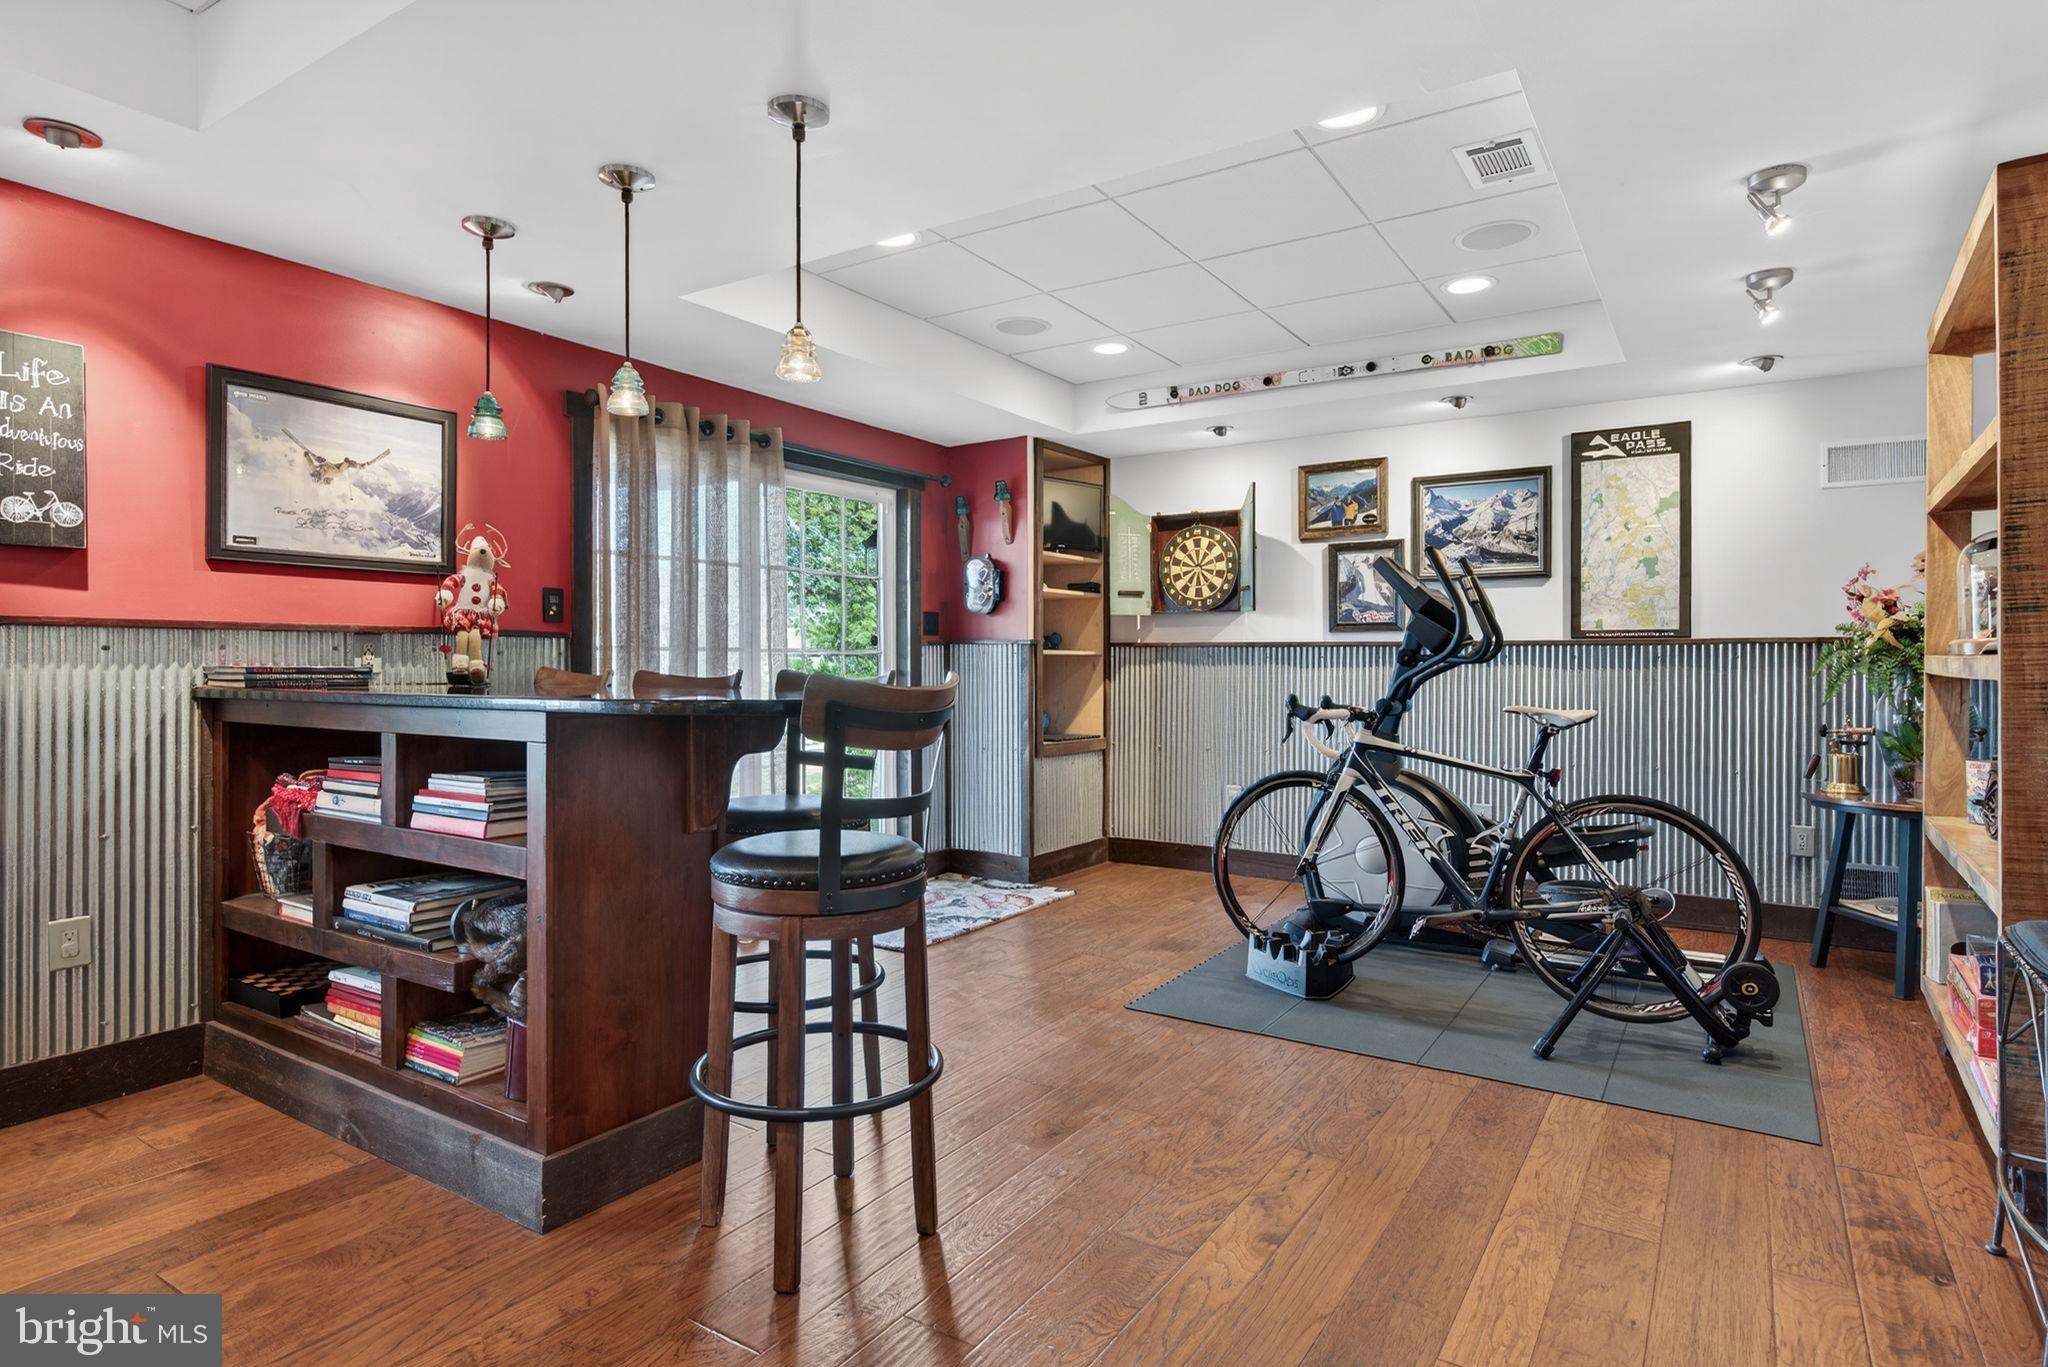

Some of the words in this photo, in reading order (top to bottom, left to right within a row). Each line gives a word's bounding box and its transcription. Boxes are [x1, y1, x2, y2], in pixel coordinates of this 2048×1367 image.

[1445, 349, 1475, 362] BAD
[0, 351, 71, 388] Life
[1188, 384, 1211, 397] BAD
[1215, 380, 1241, 393] DOG
[38, 396, 73, 420] An
[0, 416, 84, 452] dventurous
[1625, 438, 1667, 450] PASS
[0, 453, 56, 477] Ride
[1375, 781, 1441, 863] TREK
